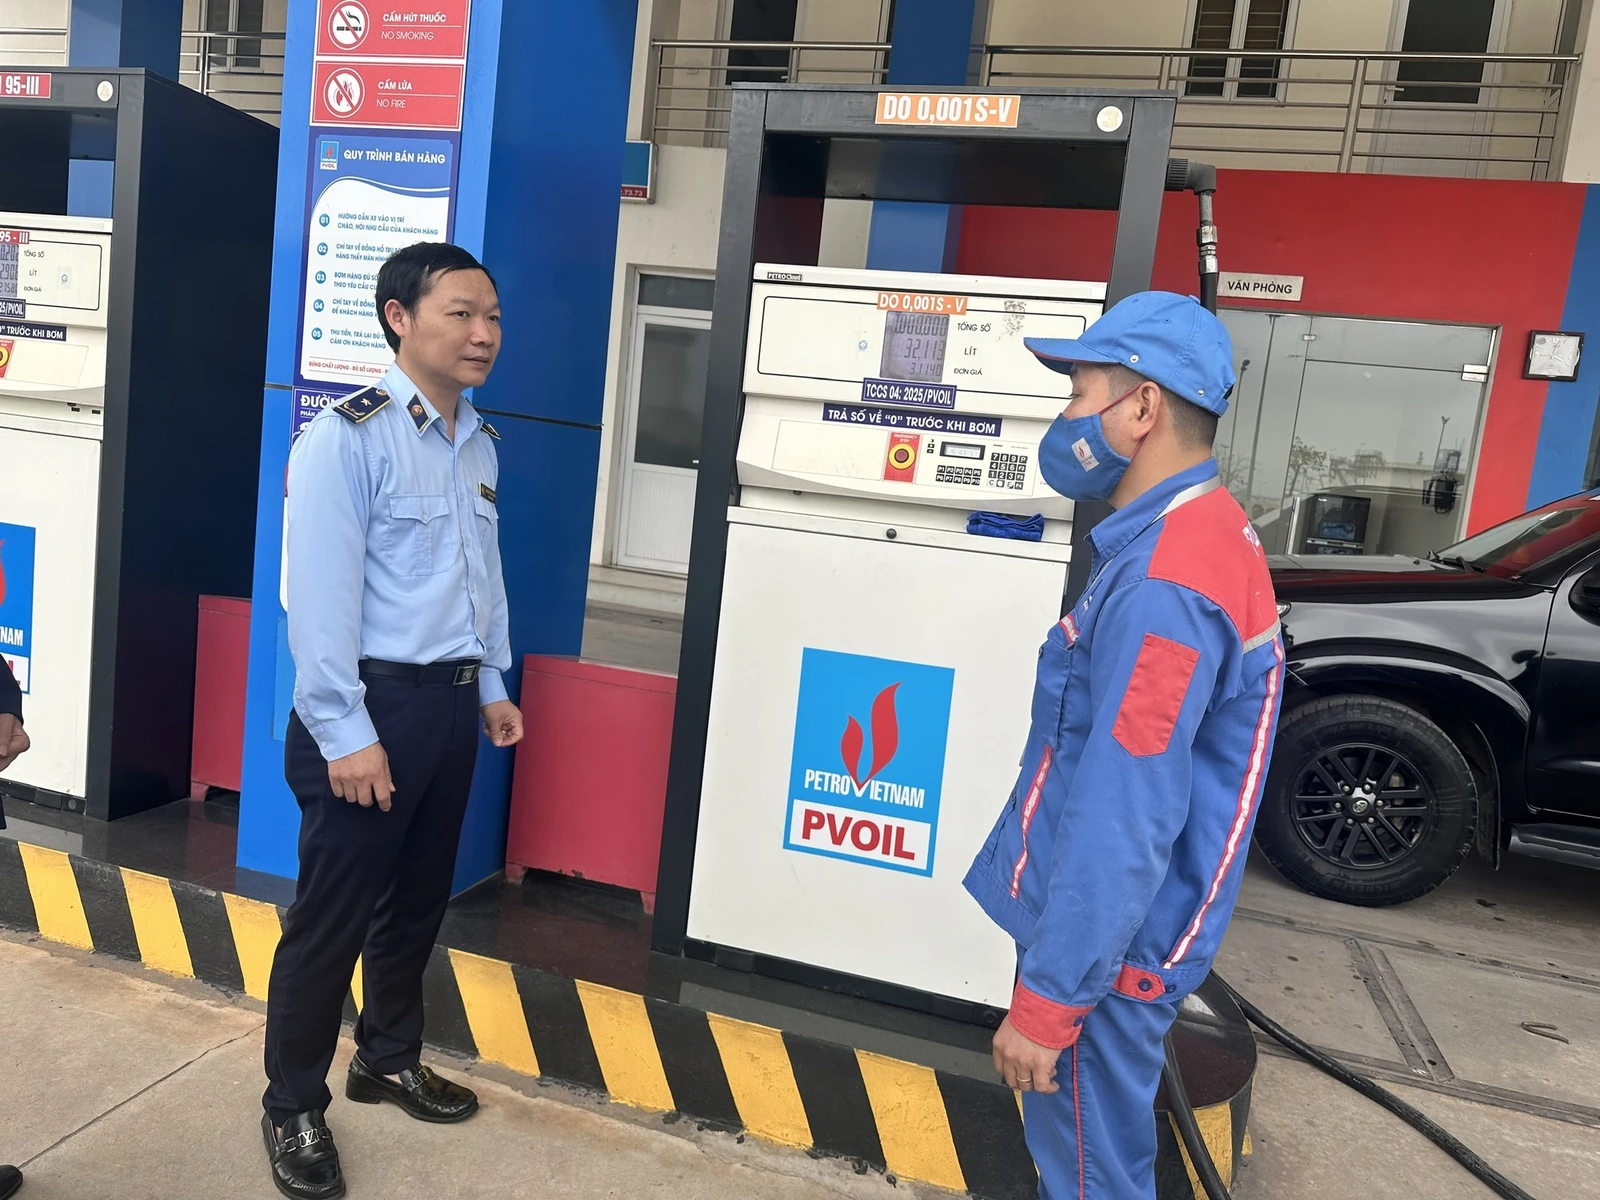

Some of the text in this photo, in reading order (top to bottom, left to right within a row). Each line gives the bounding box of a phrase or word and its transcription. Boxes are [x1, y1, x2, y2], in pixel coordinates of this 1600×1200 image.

[383, 11, 447, 23] CẤM HÚT THUỐC
[381, 31, 434, 40] NO SMOKING
[5, 75, 39, 95] 95-III
[377, 78, 412, 90] CẤM LỬA
[376, 99, 406, 108] NO FIRE
[883, 95, 1012, 124] DO 0,001S-V
[343, 148, 446, 164] QUY TRÌNH BÁN HÀNG
[391, 216, 396, 224] VỊ
[390, 225, 402, 233] CỦA
[402, 226, 421, 234] KHÁCH
[422, 227, 438, 235] HÀNG
[319, 245, 327, 253] 02
[336, 242, 345, 250] CHỈ
[38, 250, 45, 258] SỐ
[335, 252, 349, 260] HÀNG
[350, 251, 362, 260] THẤY
[363, 253, 374, 261] MÀN
[346, 271, 362, 280] HÀNG
[347, 281, 357, 289] YÊU
[357, 281, 369, 290] CẦU
[1227, 279, 1292, 294] VĂN PHÒNG
[332, 297, 342, 306] CHỈ
[879, 293, 899, 309] DO
[902, 295, 944, 312] 0,001S
[955, 298, 965, 312] V
[339, 308, 357, 316] KHÁCH
[957, 321, 991, 333] TỔNG SỐ
[6, 325, 31, 336] TRƯỚC
[32, 328, 45, 337] KHI
[46, 329, 63, 340] BƠM
[351, 339, 370, 348] KHÁCH
[371, 340, 386, 349] HÀNG
[964, 346, 977, 356] LÍT
[970, 368, 982, 376] GIÁ
[866, 383, 952, 405] TCCS 04: 2025/PVOIL
[828, 408, 848, 420] TRẢ
[850, 408, 866, 423] SỐ
[869, 409, 882, 424] VỀ
[906, 413, 944, 430] TRƯỚC
[947, 420, 966, 432] KHI
[969, 421, 996, 435] BƠM
[804, 769, 925, 809] PETROVIETNAM
[801, 808, 915, 861] PVOIL
